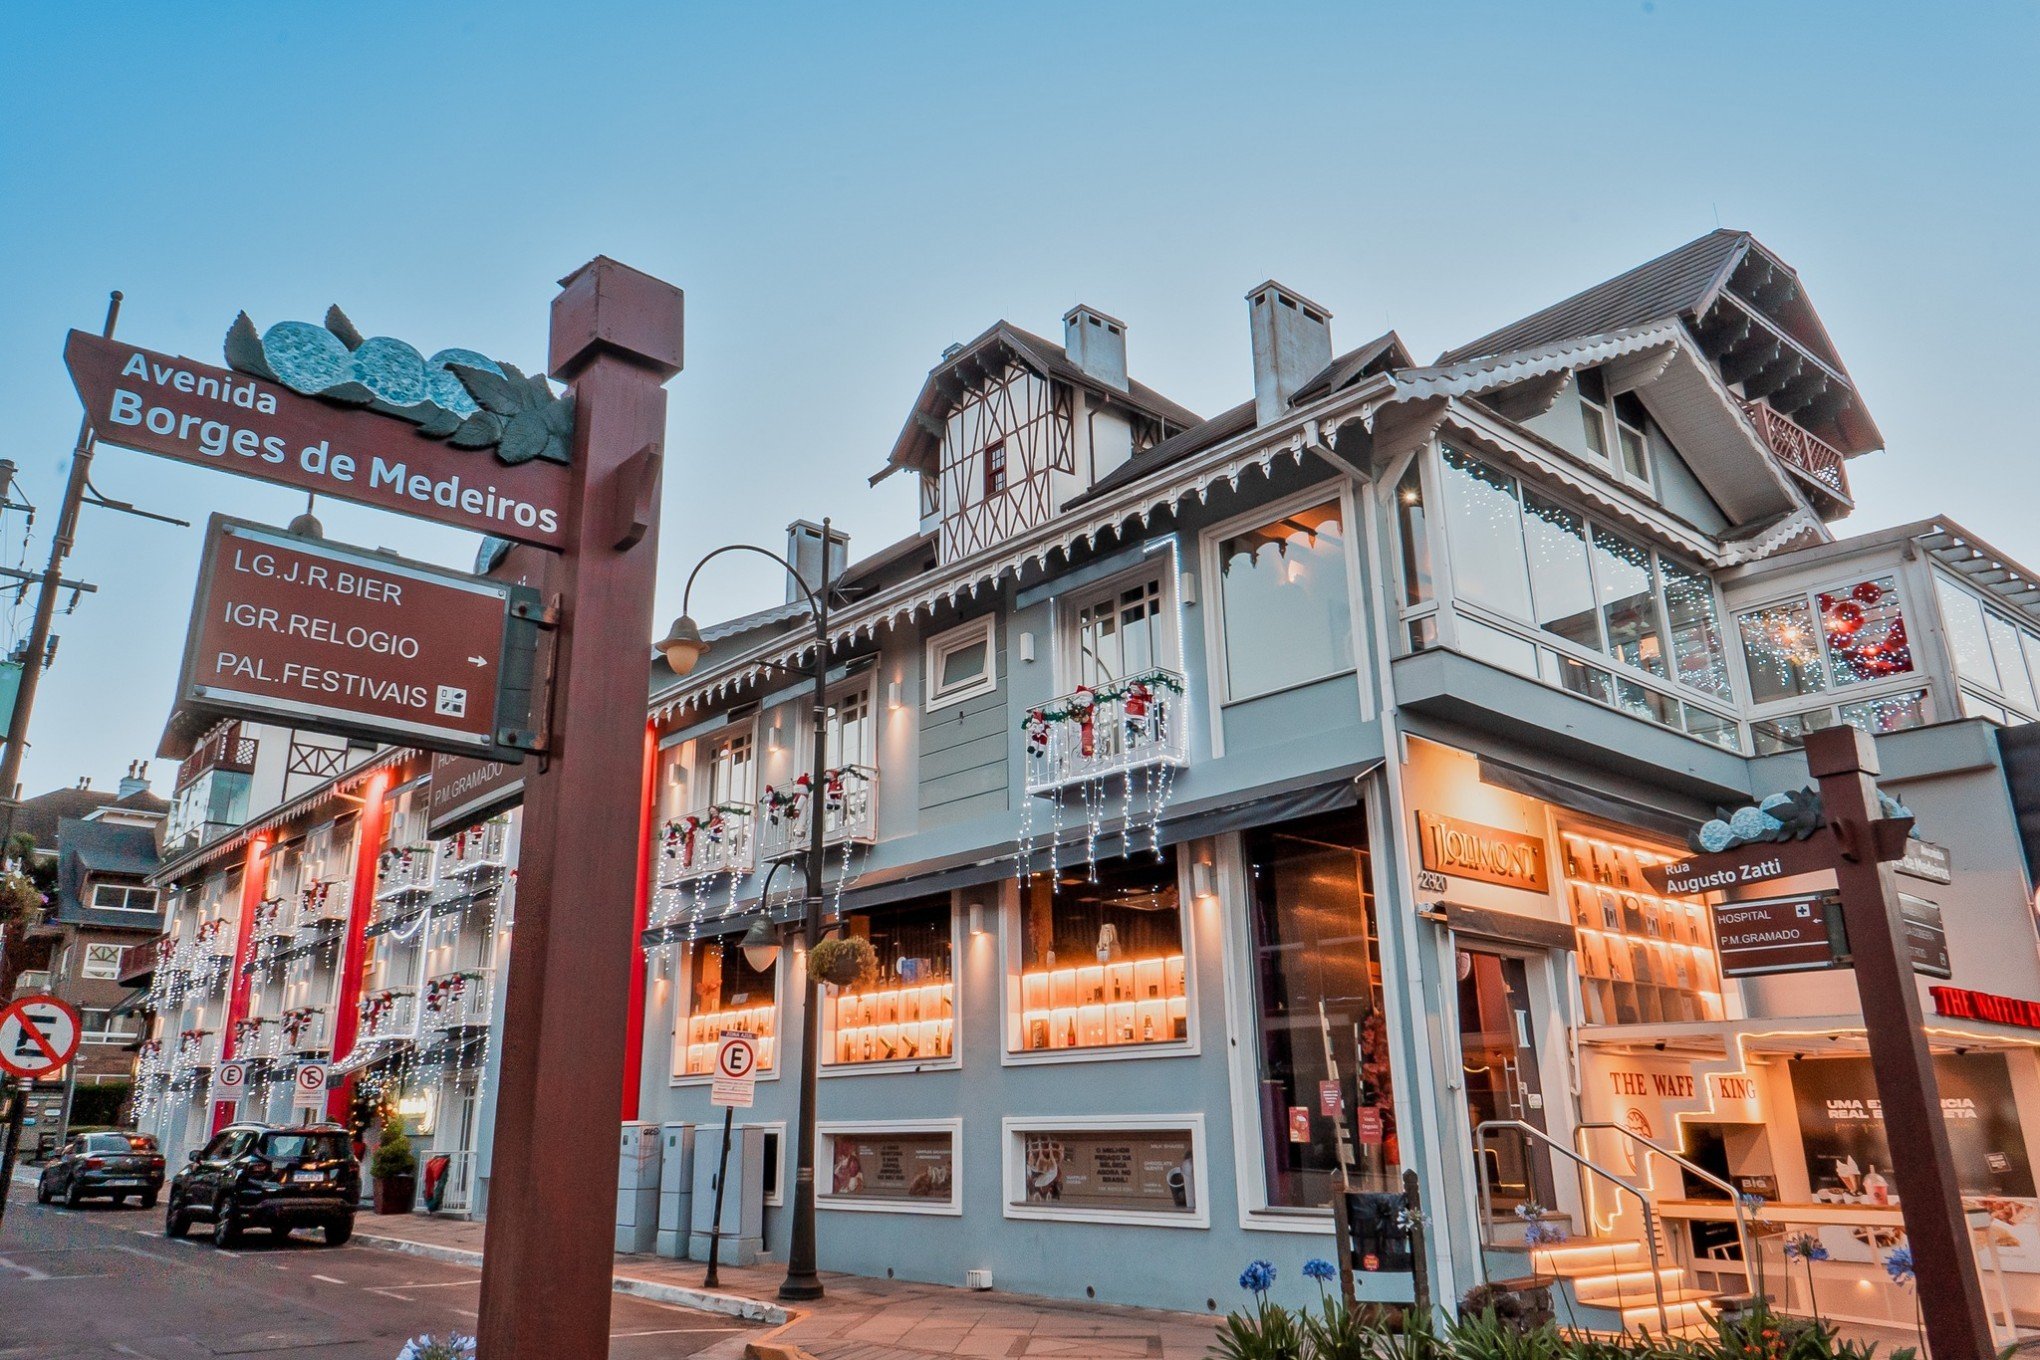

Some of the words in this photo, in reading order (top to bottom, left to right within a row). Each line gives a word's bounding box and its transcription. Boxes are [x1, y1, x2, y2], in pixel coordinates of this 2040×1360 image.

[122, 354, 276, 414] Avenida
[110, 389, 285, 462] Borges
[301, 441, 355, 480] de
[370, 457, 557, 532] Medeiros
[235, 550, 402, 606] LG.J.R.BIER
[225, 602, 419, 659] IGR.RELOGIO
[217, 653, 428, 708] PAL.FESTIVAIS
[1665, 863, 1690, 876] Rua
[1666, 869, 1736, 894] Augusto
[1739, 858, 1782, 880] Zatti
[1419, 872, 1447, 893] 2820
[1717, 910, 1772, 924] HOSPITAL
[1720, 929, 1800, 946] P.M.GRAMADO
[730, 1047, 744, 1070] E
[226, 1069, 236, 1082] E
[1610, 1072, 1648, 1096] THE
[1652, 1074, 1694, 1097] WAFF
[1719, 1077, 1756, 1099] KING
[1826, 1099, 1863, 1109] UMA
[1828, 1109, 1869, 1119] REAL
